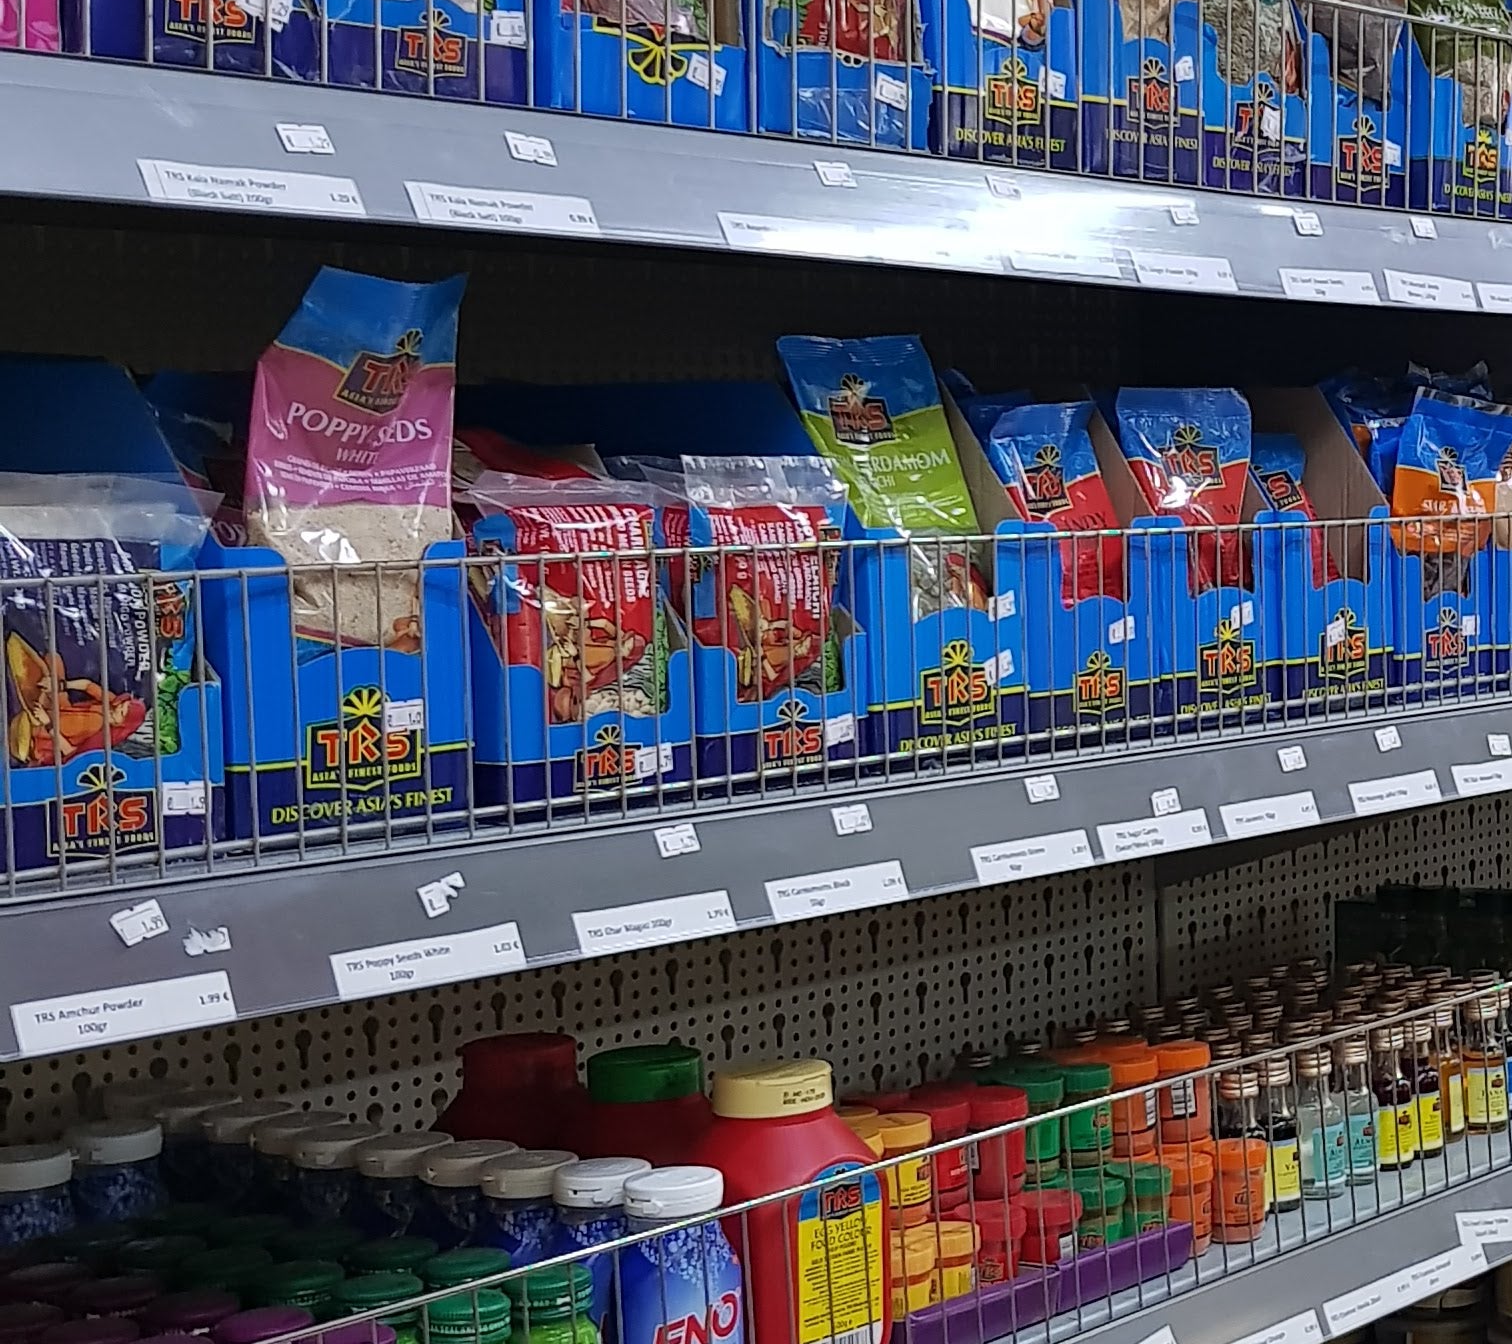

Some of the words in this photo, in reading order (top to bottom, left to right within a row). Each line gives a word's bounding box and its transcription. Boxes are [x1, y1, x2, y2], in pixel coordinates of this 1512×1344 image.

[286, 401, 375, 445] POPPY
[927, 676, 989, 703] TRS
[316, 727, 411, 766] TRS
[271, 797, 353, 825] DISCOVER
[34, 1012, 55, 1024] TRS
[102, 997, 144, 1013] Powder
[823, 1187, 862, 1215] TRS
